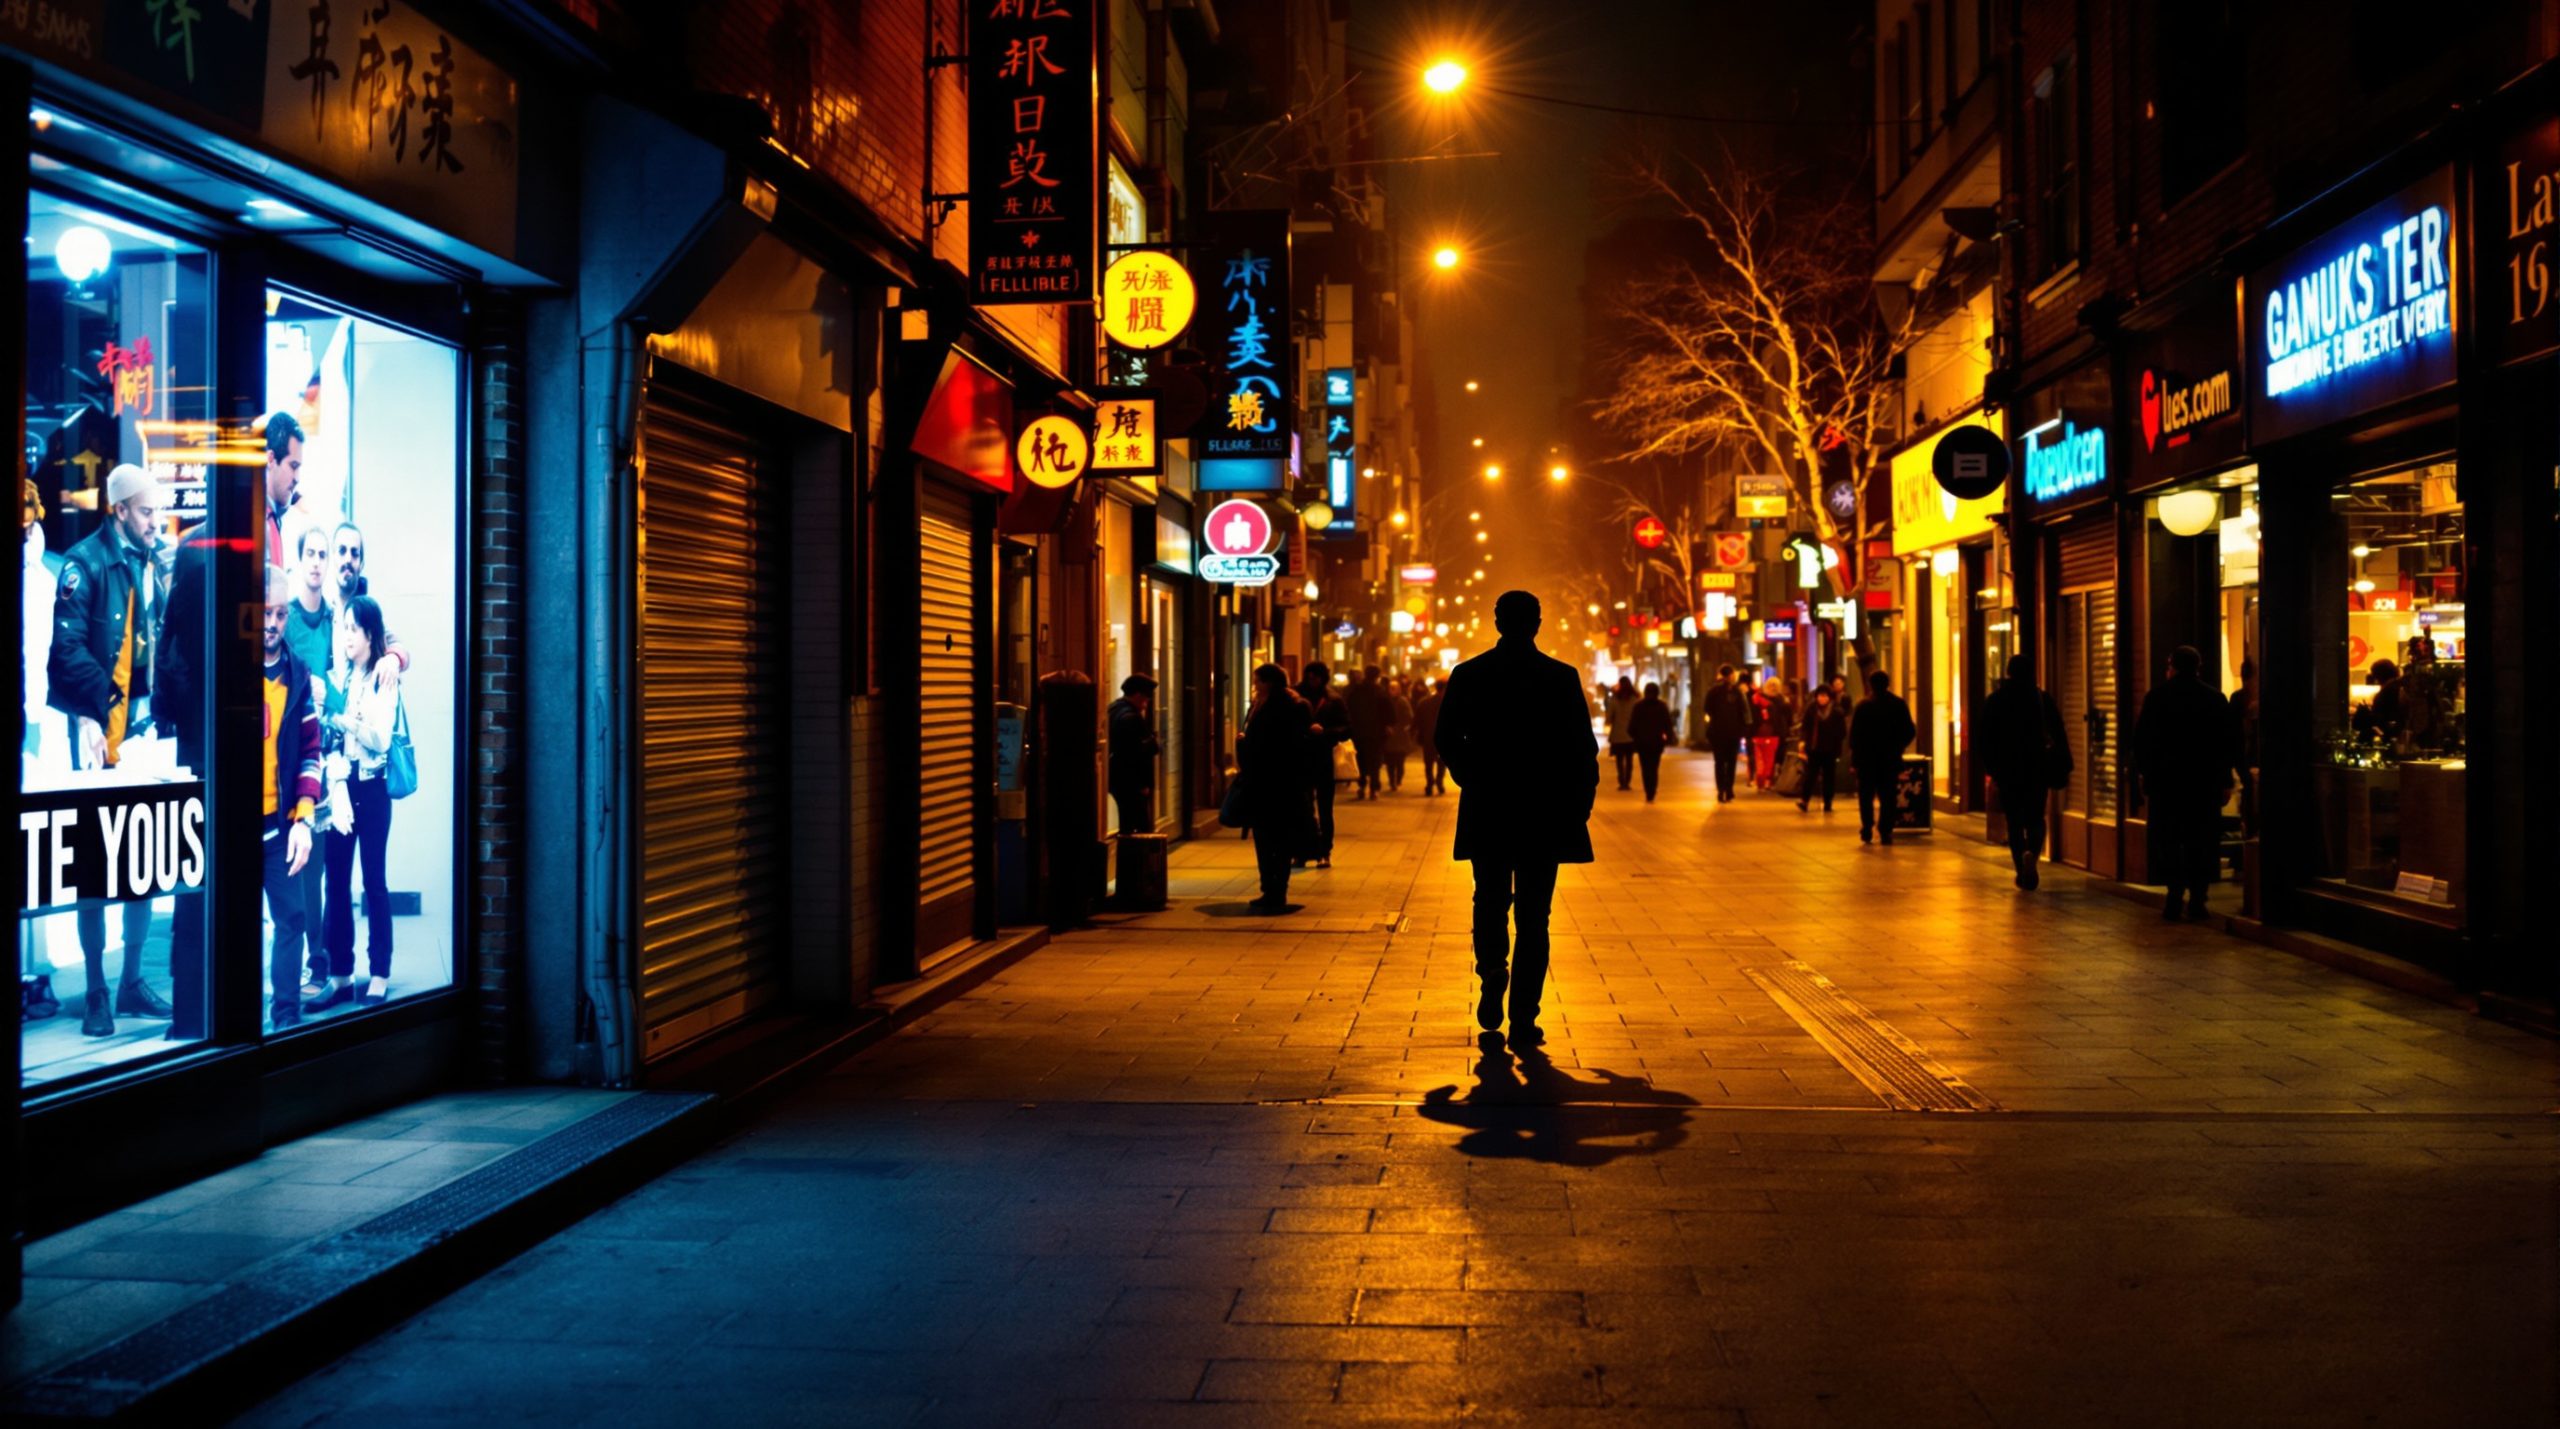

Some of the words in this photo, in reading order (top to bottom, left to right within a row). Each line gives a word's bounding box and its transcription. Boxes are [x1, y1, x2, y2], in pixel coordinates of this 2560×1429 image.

[2507, 160, 2560, 239] La
[20, 808, 78, 911] TE
[98, 797, 205, 899] YOUS
